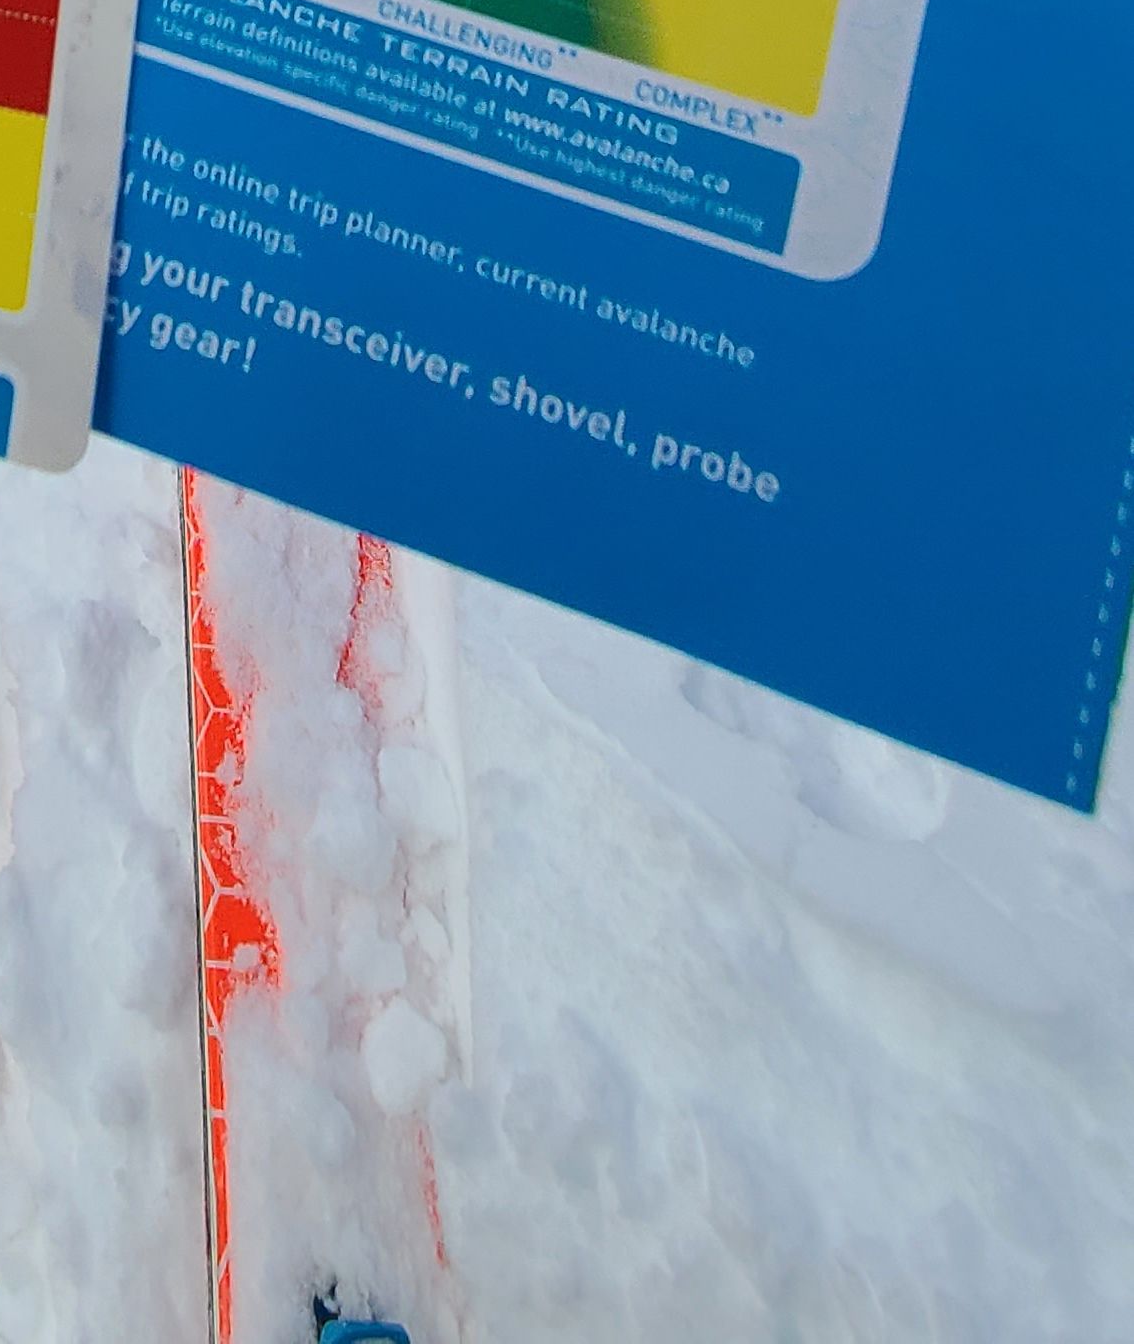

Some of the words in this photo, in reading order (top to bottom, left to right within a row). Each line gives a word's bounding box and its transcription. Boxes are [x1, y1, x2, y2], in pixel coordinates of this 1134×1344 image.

[242, 21, 357, 73] definitions
[366, 64, 466, 109] available
[380, 31, 529, 97] TERRAIN
[547, 84, 678, 146] RATING
[142, 179, 189, 220] trip
[197, 202, 303, 258] ratings.
[142, 137, 185, 170] the
[193, 158, 279, 203] online
[289, 185, 338, 227] trip
[345, 211, 465, 272] planner,
[475, 257, 588, 310] current
[596, 297, 755, 367] avalanche
[140, 250, 230, 302] your
[240, 280, 475, 400] transceiver,
[489, 374, 638, 457] shovel,
[651, 432, 780, 503] probe
[149, 312, 258, 374] gear!
